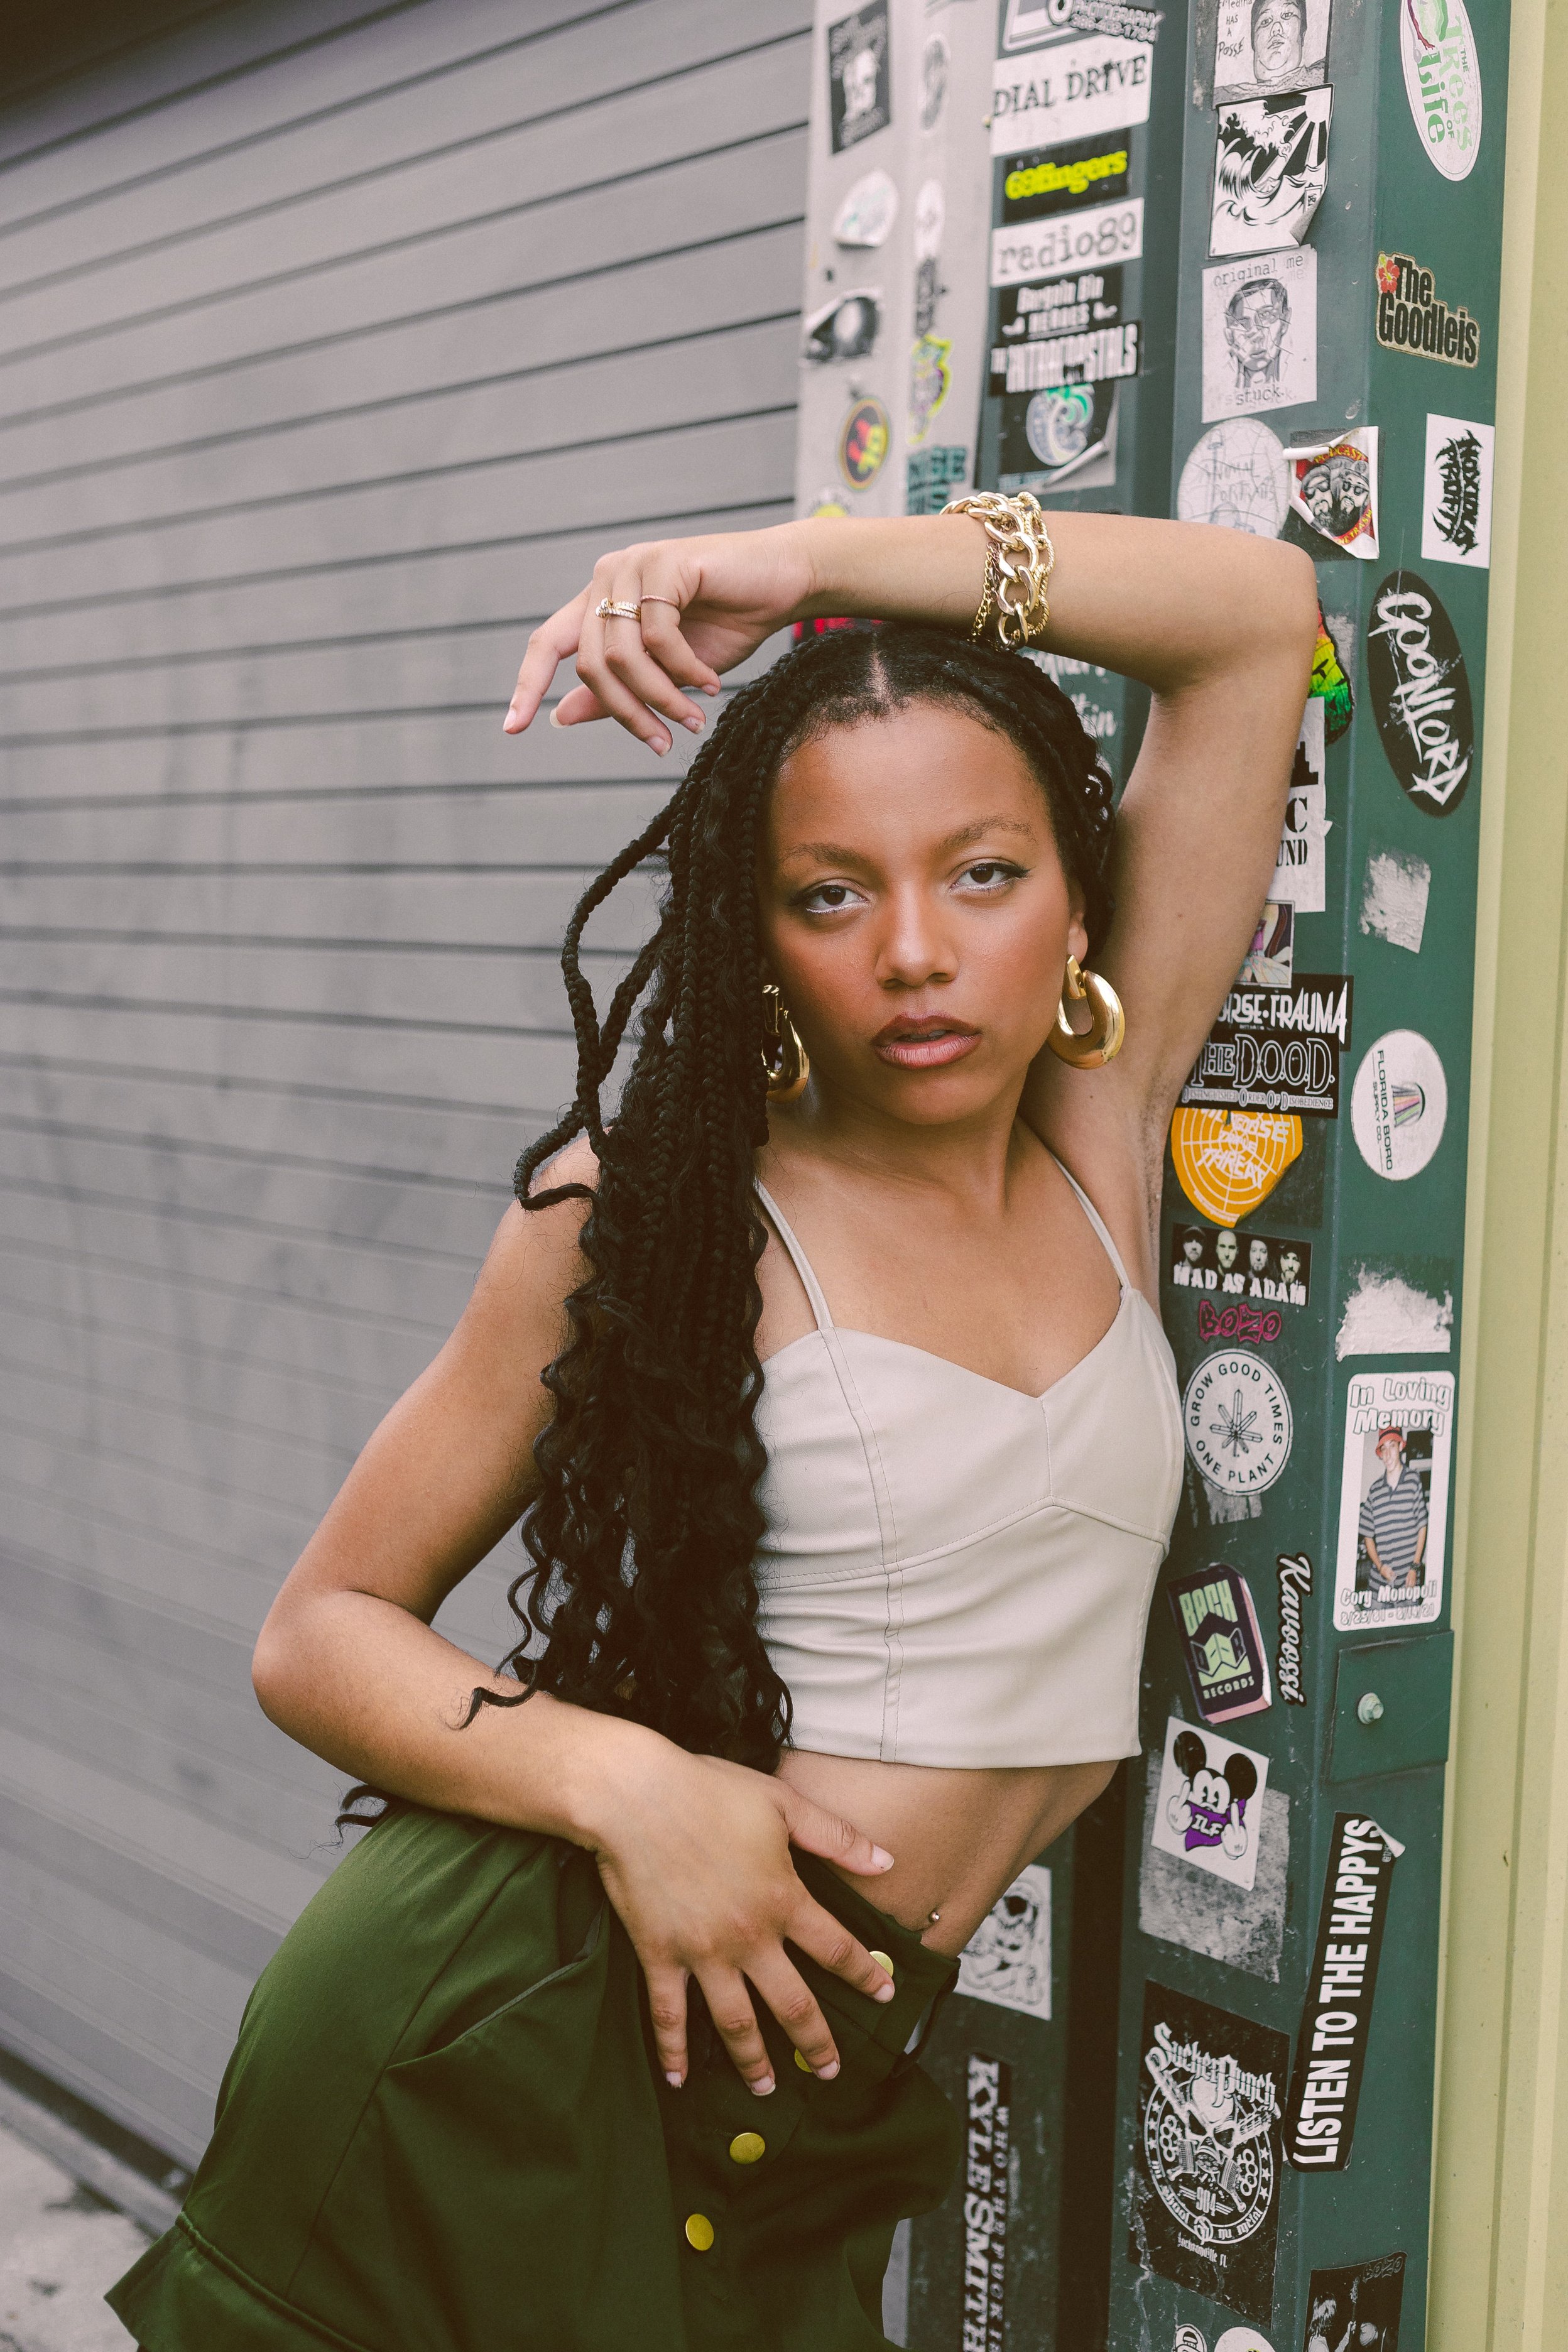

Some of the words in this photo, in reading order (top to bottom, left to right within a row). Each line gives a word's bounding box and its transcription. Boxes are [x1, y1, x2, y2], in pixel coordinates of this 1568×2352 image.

[1226, 14, 1239, 25] HAS
[1227, 28, 1233, 37] A
[1460, 48, 1469, 73] THE
[993, 79, 1055, 117] DIAL
[1065, 52, 1147, 101] DRIVE
[1417, 50, 1448, 144] Life
[1447, 119, 1455, 139] OF
[1213, 258, 1278, 287] original
[1286, 254, 1304, 269] me
[1394, 256, 1432, 308] The
[1378, 290, 1477, 364] Goodleis
[1276, 839, 1309, 868] UND
[1377, 1050, 1389, 1121] FLORIDA
[1383, 1125, 1393, 1171] BORO
[1173, 1263, 1218, 1290] MAD
[1222, 1273, 1246, 1294] AS
[1249, 1277, 1307, 1306] ADAM
[1199, 1299, 1282, 1344] BOZO
[1190, 1372, 1213, 1427] GROW
[1218, 1361, 1261, 1382] GOOD
[1265, 1383, 1283, 1445] TIMES
[1350, 1384, 1375, 1408] In
[1383, 1376, 1451, 1412] Loving
[1353, 1407, 1444, 1437] Memory
[1195, 1440, 1222, 1475] ONE
[1228, 1452, 1274, 1483] PLANT
[1340, 1587, 1373, 1609] Cory
[1202, 1675, 1255, 1700] RECORDS
[1329, 1818, 1384, 1935] HAPPYS
[1319, 1944, 1368, 2003] THE
[1312, 2010, 1358, 2052] TO
[1292, 2059, 1351, 2165] LISTEN
